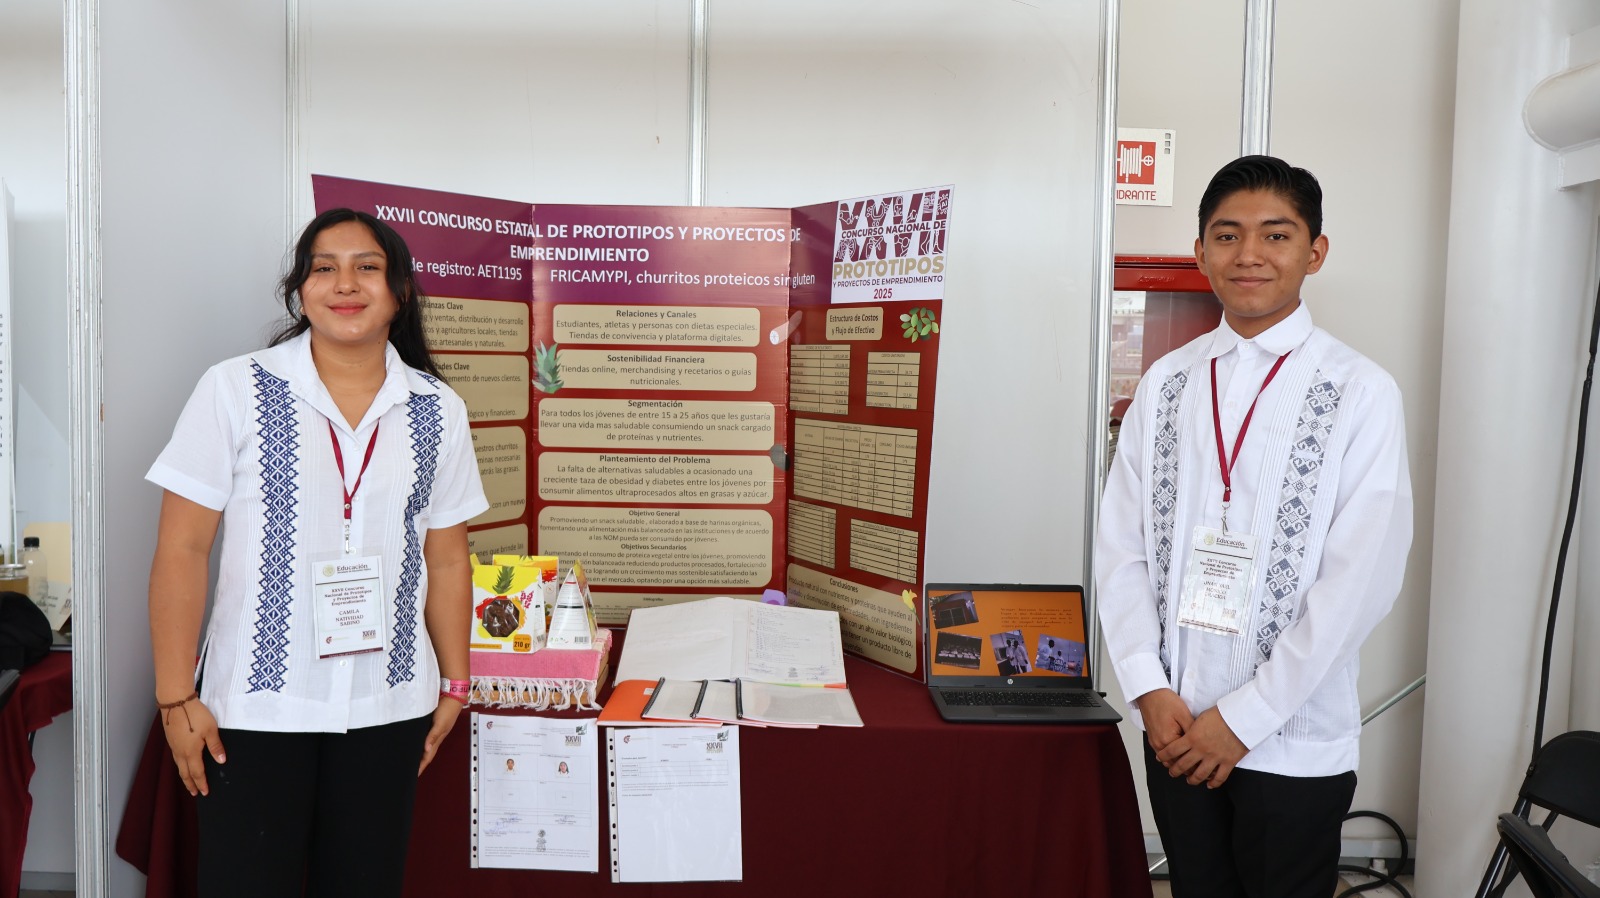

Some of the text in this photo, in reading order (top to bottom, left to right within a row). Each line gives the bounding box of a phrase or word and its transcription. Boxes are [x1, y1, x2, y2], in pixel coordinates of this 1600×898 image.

[1116, 190, 1156, 200] IDRANTE
[376, 204, 801, 242] XXVII CONCURSO ESTATAL DE PROTOTIPOS Y PROYECTOS DE
[842, 220, 946, 238] CONCURSO NACIONAL DE
[510, 244, 650, 262] EMPRENDIMIENTO
[427, 260, 475, 278] registro:
[477, 263, 522, 281] AET1195
[832, 256, 944, 280] PROTOTIPOS
[550, 269, 632, 286] FRICAMYPI,
[636, 270, 700, 284] churritos
[704, 271, 770, 288] proteicos
[792, 272, 815, 288] gluten
[838, 279, 871, 288] PROYECTOS
[882, 275, 943, 285] EMPRENDIMIENTO
[874, 288, 893, 299] 2025
[447, 302, 463, 310] Clave
[616, 309, 658, 318] Relaciones
[667, 310, 697, 319] Canales
[459, 315, 492, 324] distribución
[556, 320, 602, 329] Estudiantes,
[638, 323, 673, 331] personas
[691, 322, 714, 330] dietas
[716, 322, 757, 332] especiales.
[836, 327, 847, 335] Flujo
[441, 327, 476, 336] agricultores
[569, 332, 598, 340] Tiendas
[600, 332, 610, 340] de
[612, 332, 657, 340] convivencia
[665, 332, 707, 342] plataforma
[710, 333, 744, 343] digitales.
[607, 354, 705, 364] Sostenibilidad Financiera
[561, 365, 590, 373] Tiendas
[592, 365, 618, 374] online,
[620, 366, 676, 376] merchandising
[685, 366, 722, 375] recetarios
[630, 377, 681, 386] nutricionales.
[628, 400, 683, 408] Segmentación
[595, 410, 624, 419] jóvenes
[618, 433, 654, 442] proteínas
[598, 466, 642, 474] alternativas
[644, 466, 684, 474] saludables
[722, 479, 751, 488] jóvenes
[616, 488, 676, 497] ultraprocesados
[1216, 537, 1245, 547] Educación
[336, 563, 368, 571] Educación
[830, 578, 858, 593] Conclusiones
